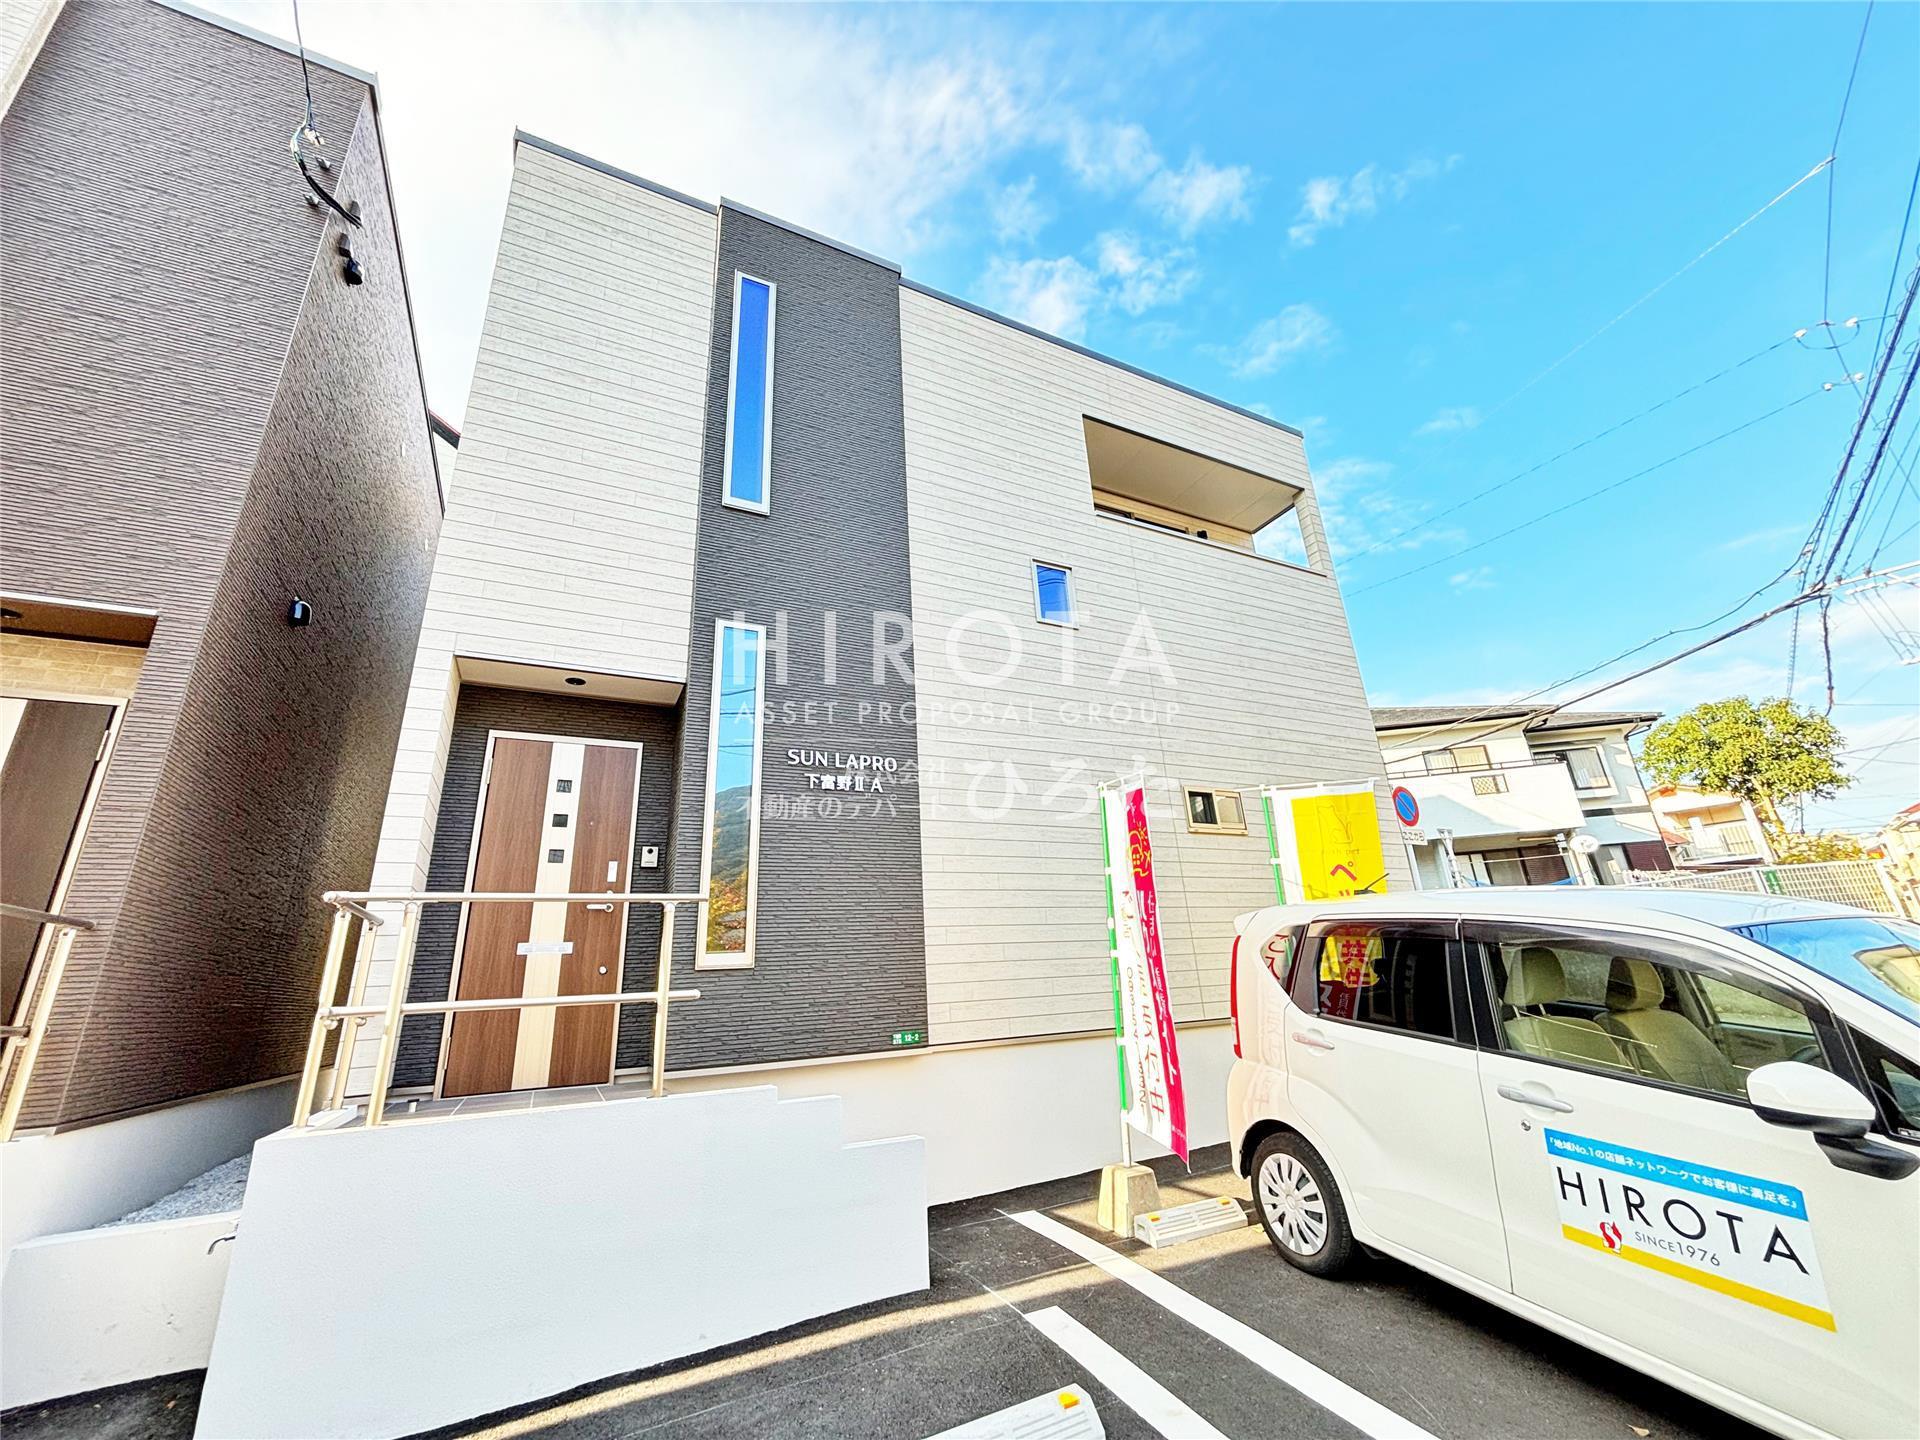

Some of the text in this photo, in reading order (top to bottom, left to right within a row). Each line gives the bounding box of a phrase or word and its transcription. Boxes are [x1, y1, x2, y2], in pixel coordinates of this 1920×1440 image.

[787, 749, 898, 773] SUN LAPRO
[1556, 1166, 1810, 1276] HIROTA
[1634, 1231, 1721, 1267] SINCE1976
